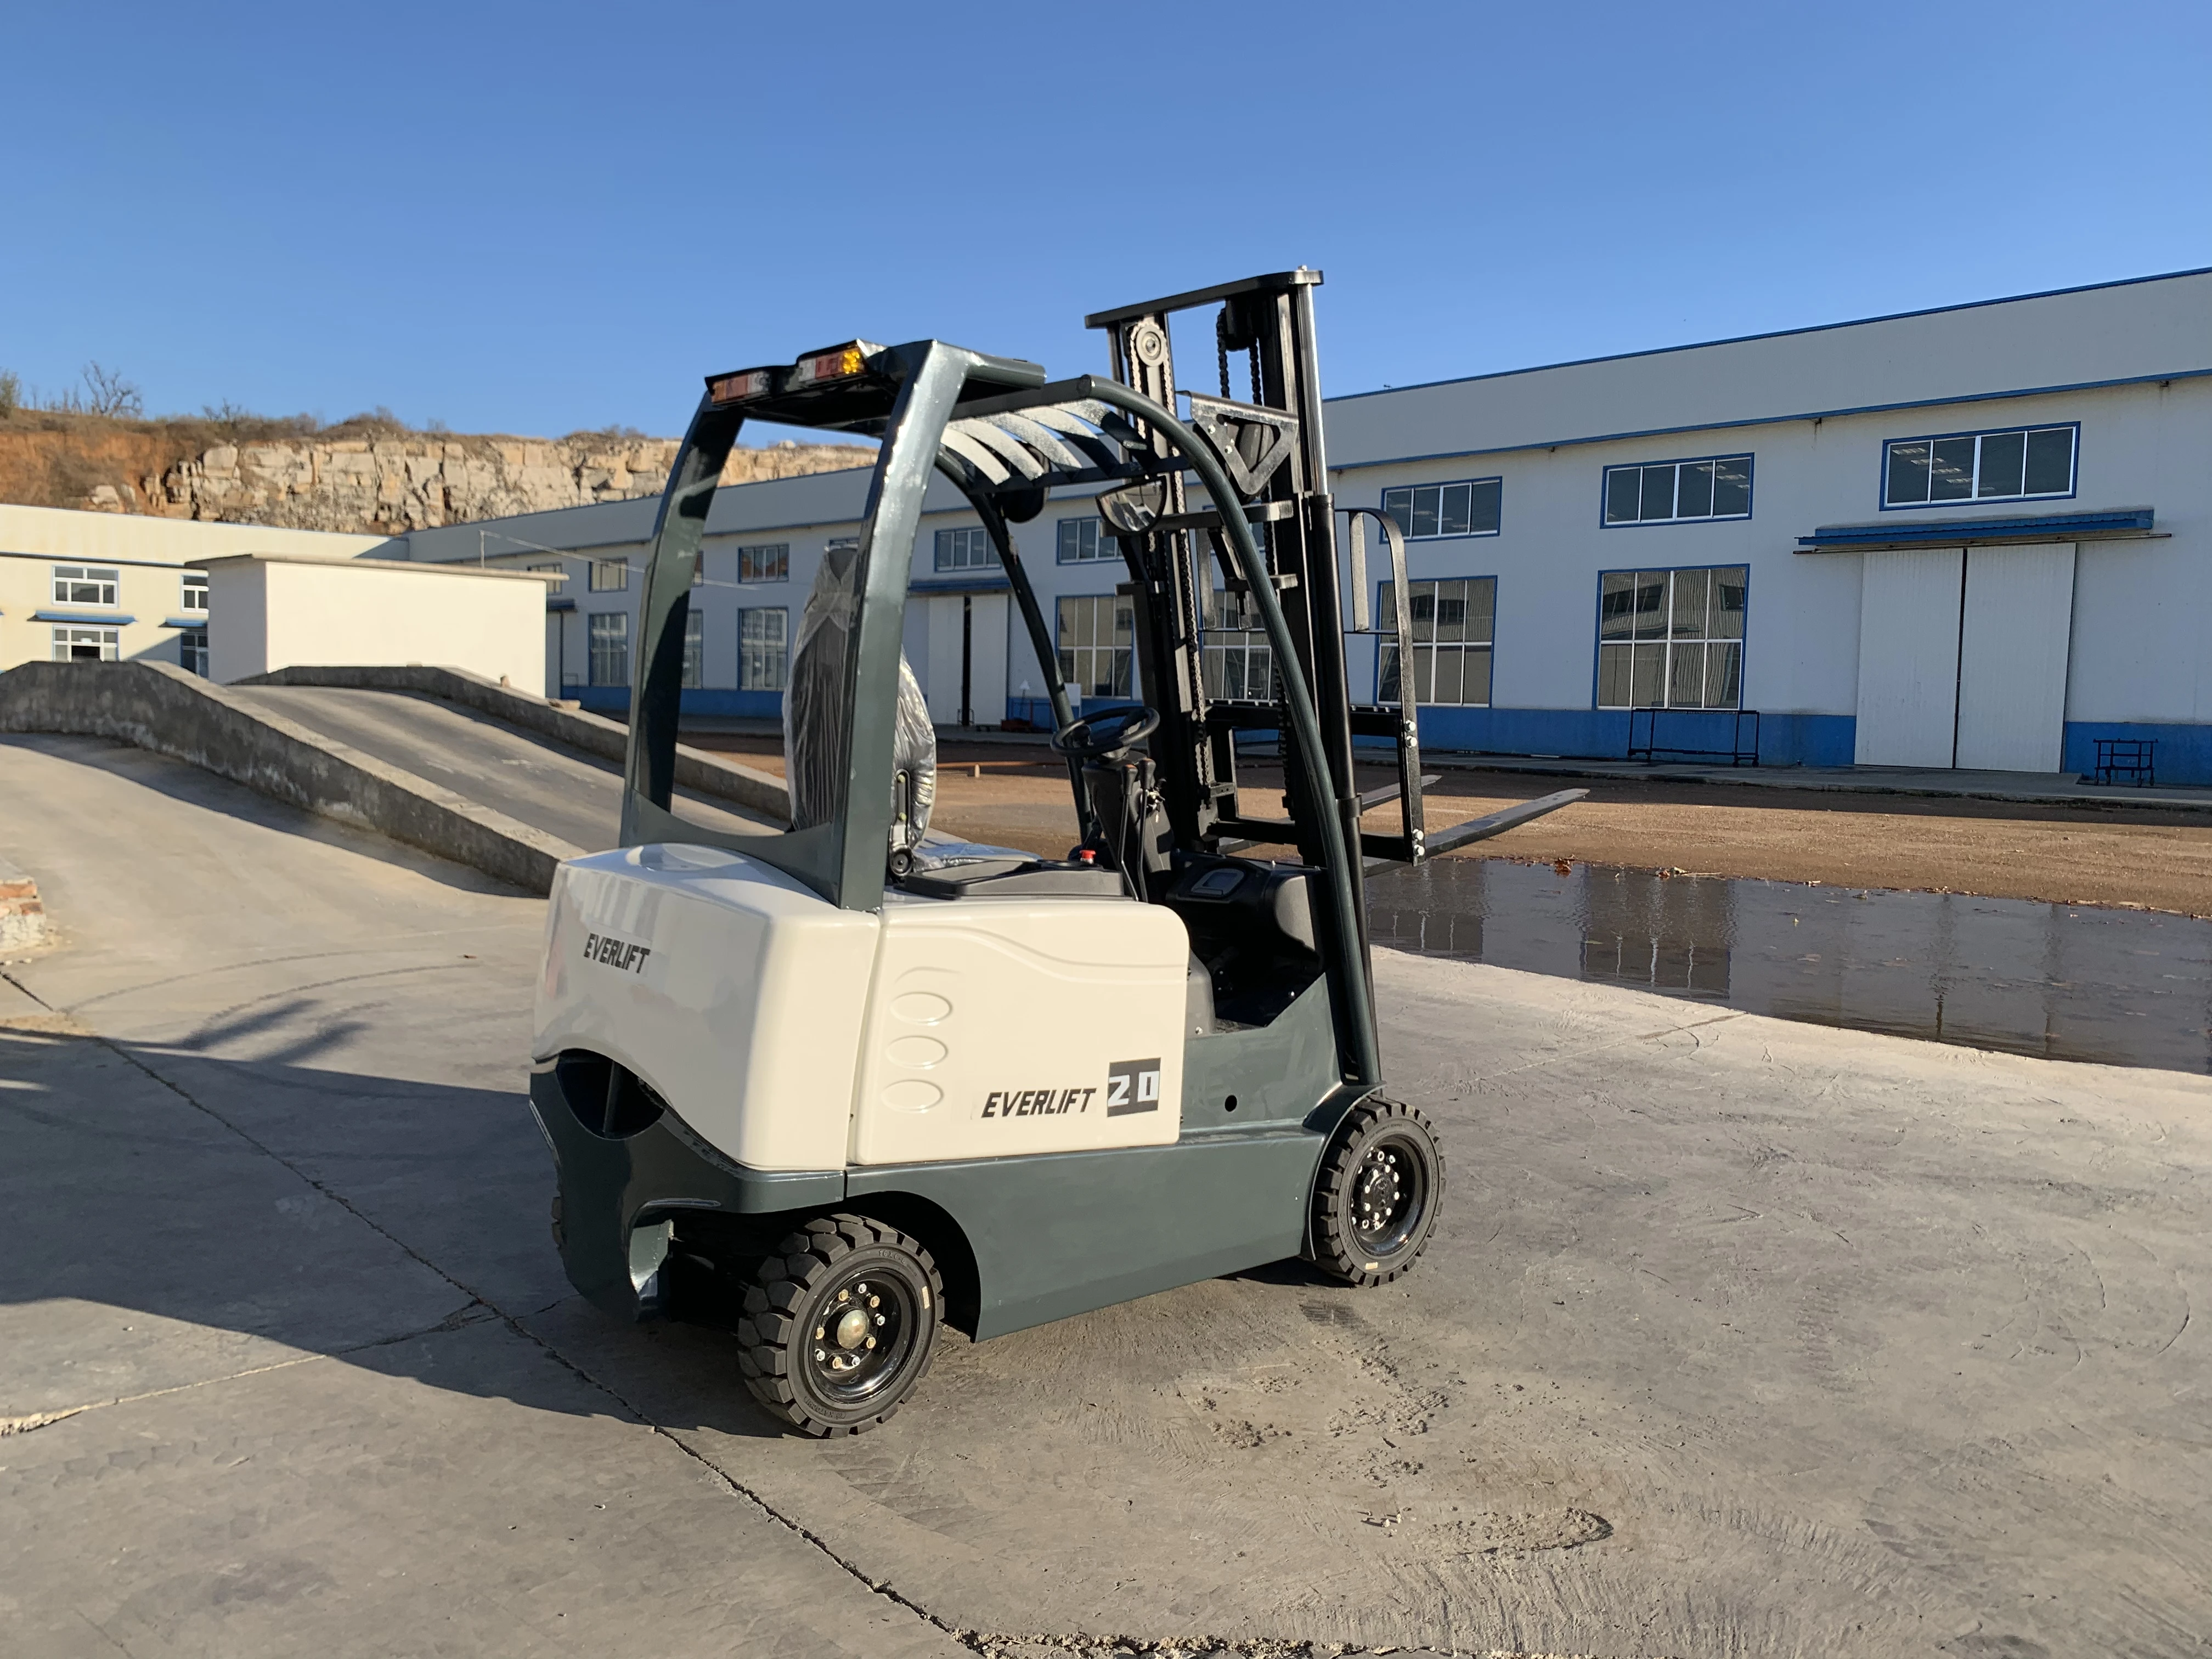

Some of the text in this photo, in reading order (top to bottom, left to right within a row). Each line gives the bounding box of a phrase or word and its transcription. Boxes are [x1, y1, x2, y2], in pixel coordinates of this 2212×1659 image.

[584, 933, 651, 974] EVERLIFT
[981, 1070, 1161, 1118] EVERLIFT 20
